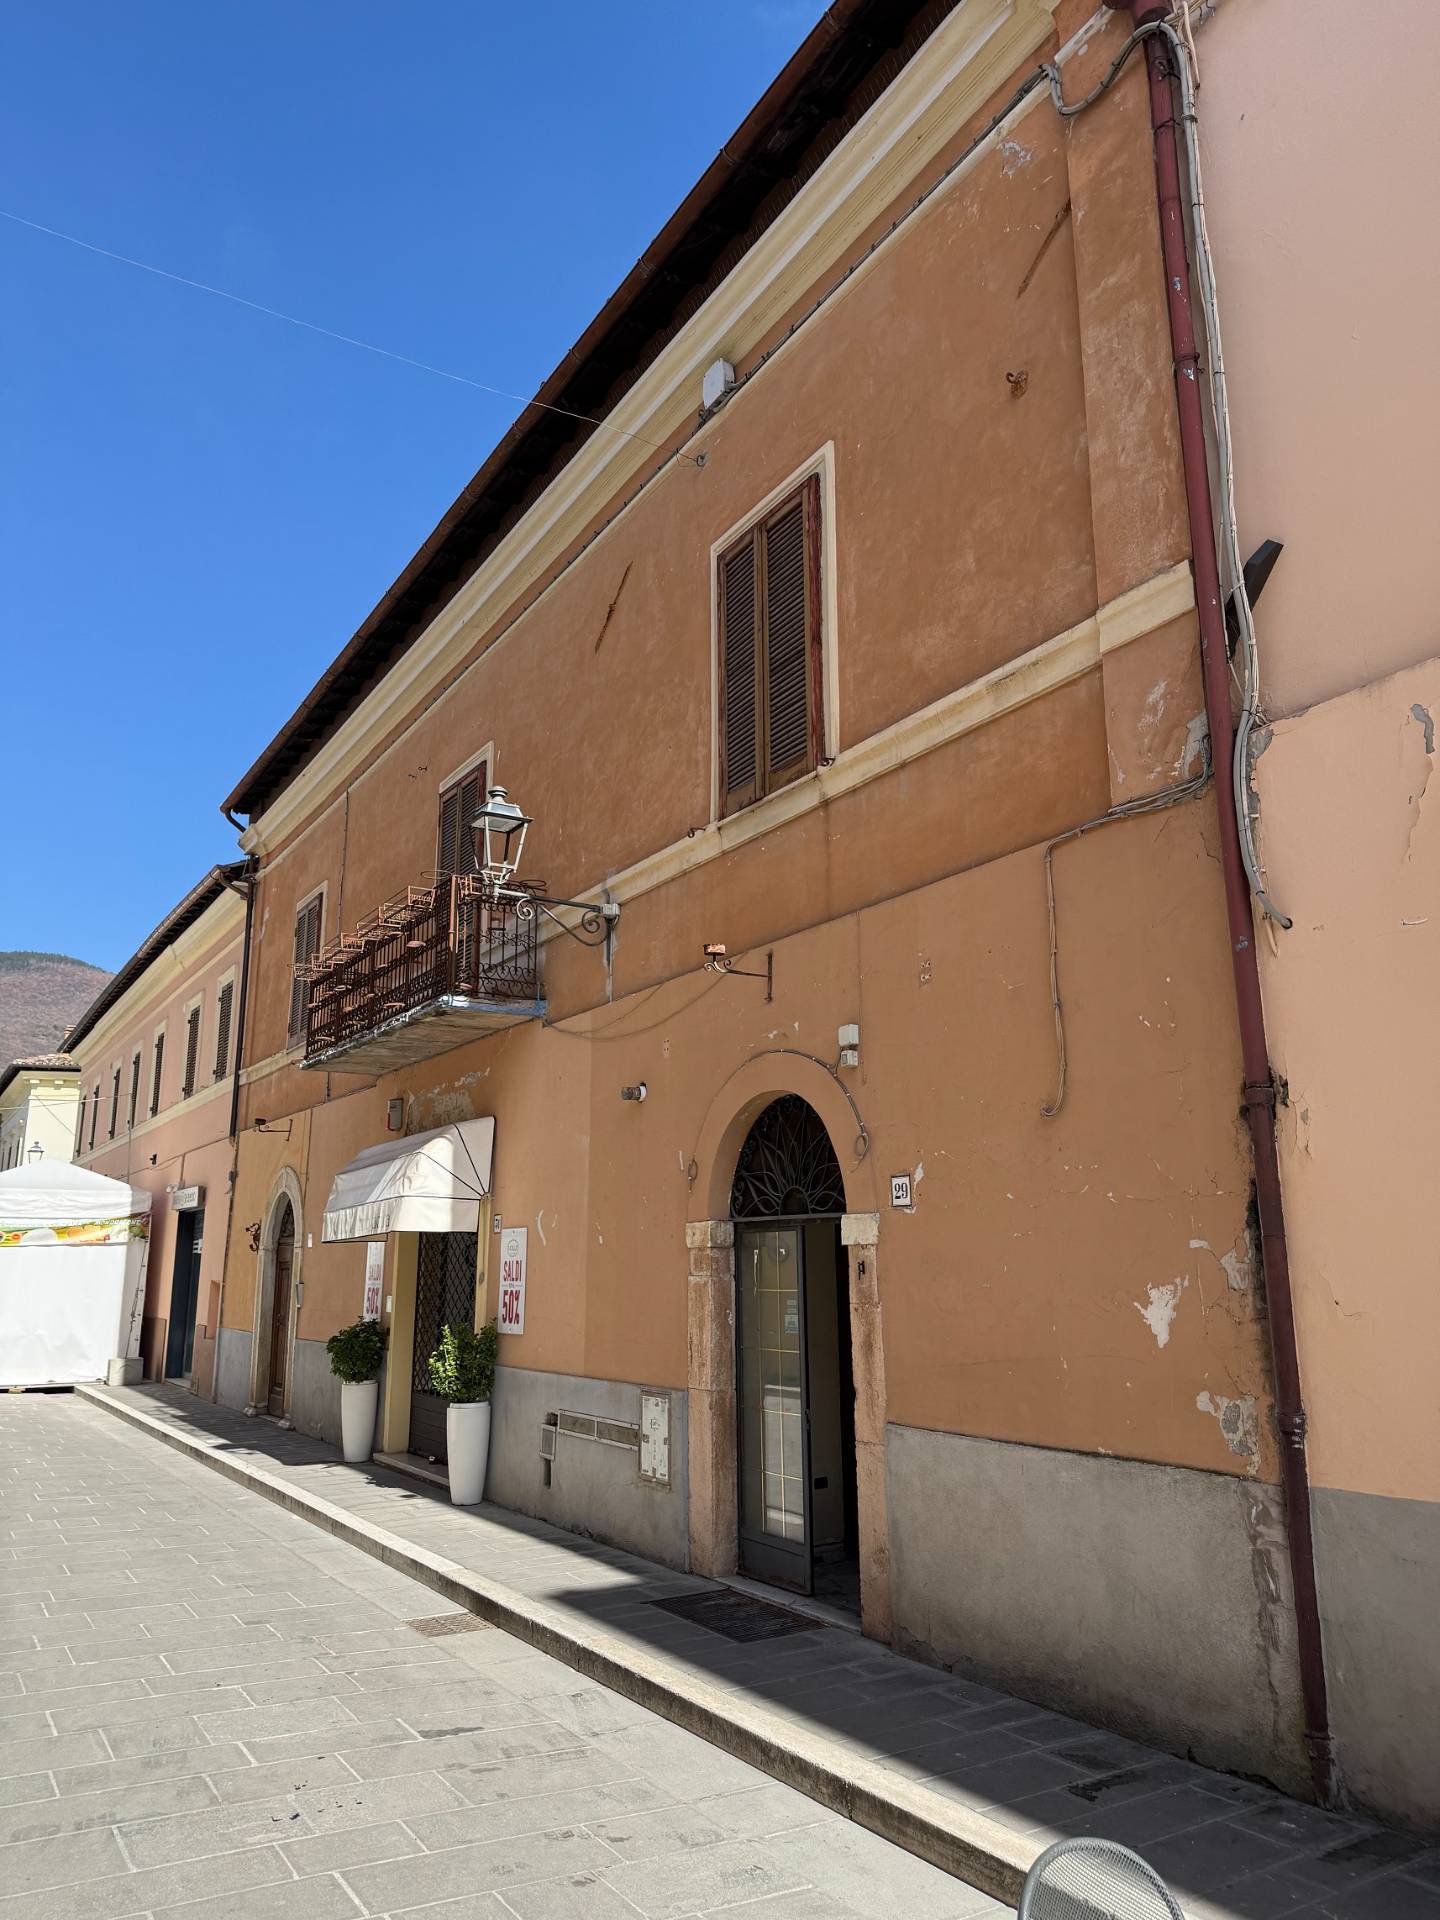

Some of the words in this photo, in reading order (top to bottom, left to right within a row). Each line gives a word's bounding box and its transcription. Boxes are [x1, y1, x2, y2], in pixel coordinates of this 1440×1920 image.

[894, 1182, 908, 1199] 29
[503, 1260, 522, 1282] SALDI
[366, 1287, 379, 1315] 50%
[502, 1289, 520, 1325] 50%
